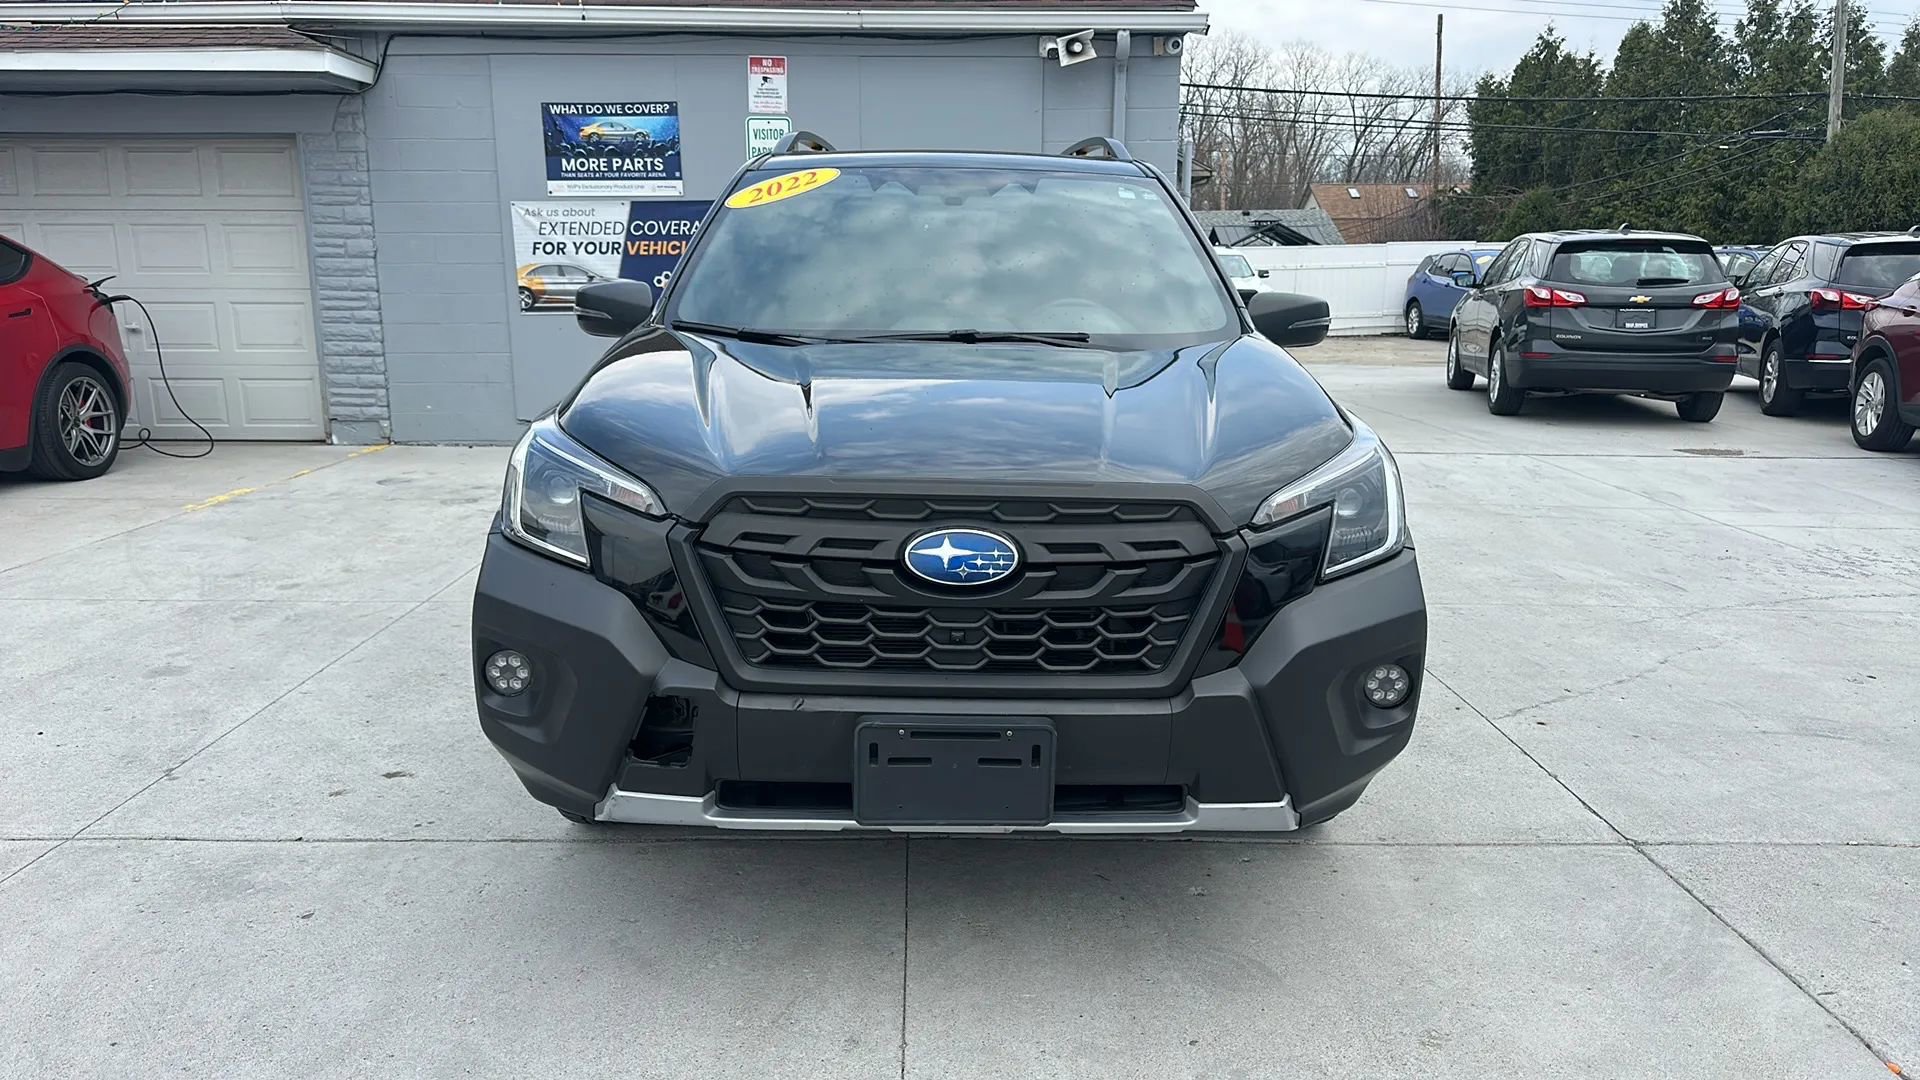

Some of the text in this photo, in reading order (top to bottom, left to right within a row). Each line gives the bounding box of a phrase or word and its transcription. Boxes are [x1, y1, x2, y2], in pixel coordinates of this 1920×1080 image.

[762, 58, 773, 67] NO
[751, 66, 784, 74] TRESPASSING
[549, 103, 669, 114] WHAT DO WE COVER?
[753, 128, 785, 140] VISITOR
[561, 157, 664, 171] MORE PARTS
[749, 171, 818, 203] 2022
[524, 208, 596, 217] Ask us about
[538, 221, 625, 236] EXTENDED
[532, 241, 567, 255] FOR
[573, 241, 622, 255] YOUR
